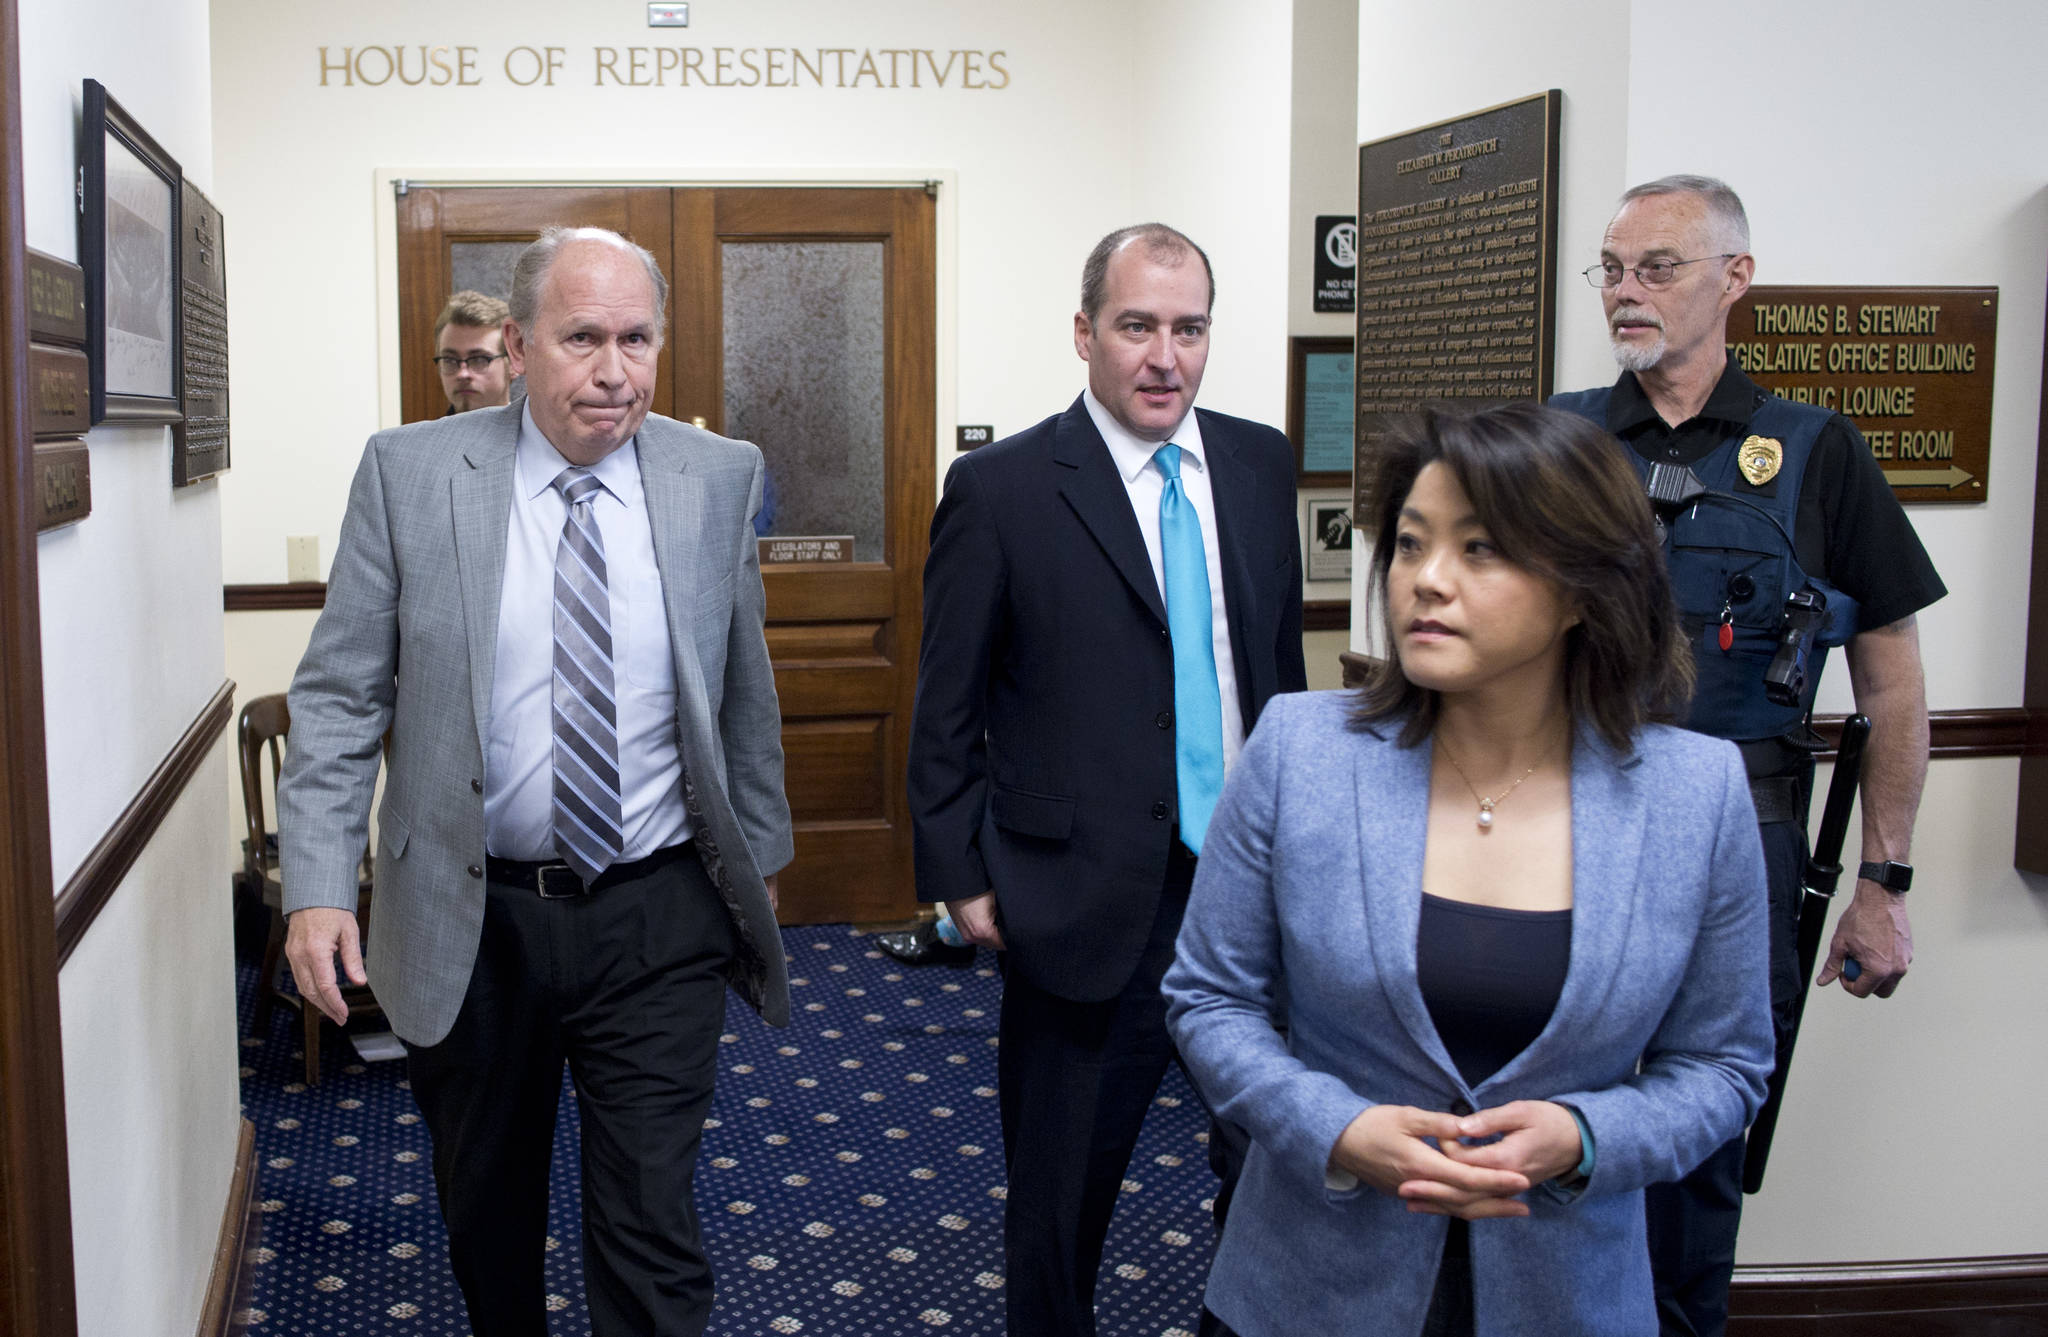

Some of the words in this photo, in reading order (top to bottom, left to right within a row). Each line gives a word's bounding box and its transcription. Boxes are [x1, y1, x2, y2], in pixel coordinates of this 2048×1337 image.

[318, 45, 482, 87] HOUSE
[504, 46, 567, 87] OF
[593, 46, 1011, 90] REPRESENTATIVES
[1397, 154, 1435, 174] ELIZABETH
[1443, 137, 1499, 163] PERATROVICH
[1427, 165, 1463, 185] GALLERY
[1318, 290, 1349, 299] PHONE
[1326, 280, 1340, 288] NO
[1341, 280, 1354, 289] CE
[1754, 304, 1829, 334] THOMAS
[1835, 304, 1851, 333] B.
[1858, 304, 1941, 333] STEWART
[1725, 343, 1822, 372] GISLATIVE
[1828, 342, 1890, 372] OFFICE
[1896, 343, 1976, 372] BUILDING
[1842, 386, 1916, 416] LOUNGE
[964, 428, 987, 441] 220
[1900, 430, 1954, 458] ROOM
[769, 551, 794, 561] FLOOR
[796, 551, 819, 561] STAFF
[821, 551, 842, 560] ONLY
[771, 541, 822, 552] LEGISLATORS
[823, 541, 840, 551] AND
